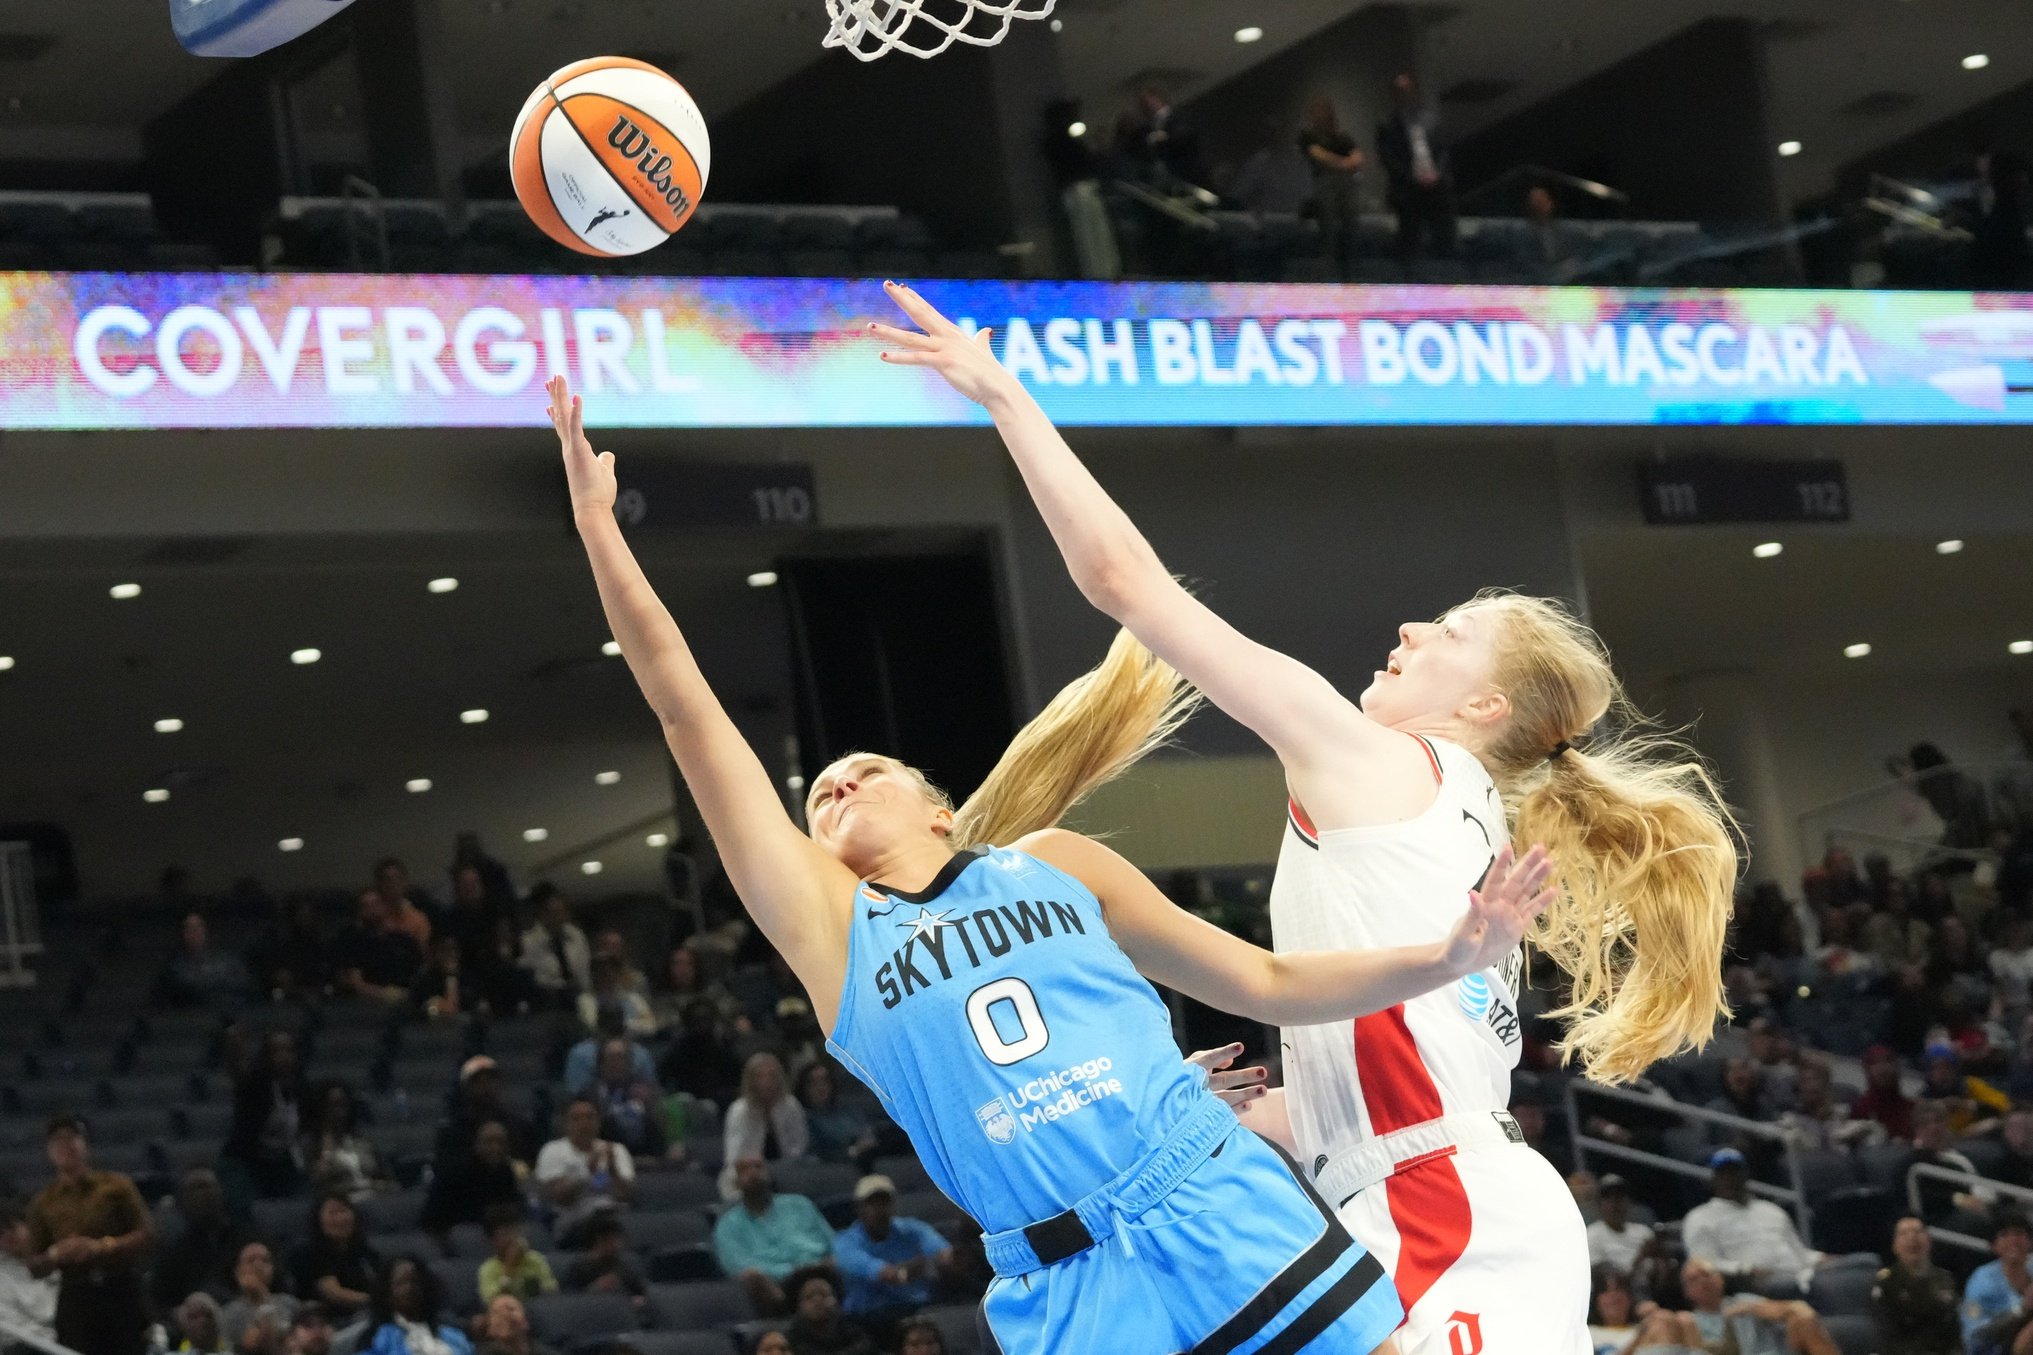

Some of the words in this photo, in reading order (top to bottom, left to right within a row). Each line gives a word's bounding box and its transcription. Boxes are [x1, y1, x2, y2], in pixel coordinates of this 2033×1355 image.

[607, 114, 690, 221] Wilson
[74, 304, 701, 396] COVERGIRL
[1149, 317, 1346, 386] BLAST
[1358, 319, 1554, 387] BOND
[1562, 321, 1869, 386] MASCARA
[752, 486, 811, 522] 110
[874, 899, 1087, 1010] SKYTOWN
[965, 976, 1050, 1066] 0
[1008, 1056, 1113, 1110] UChicago
[1018, 1076, 1124, 1134] Medicine
